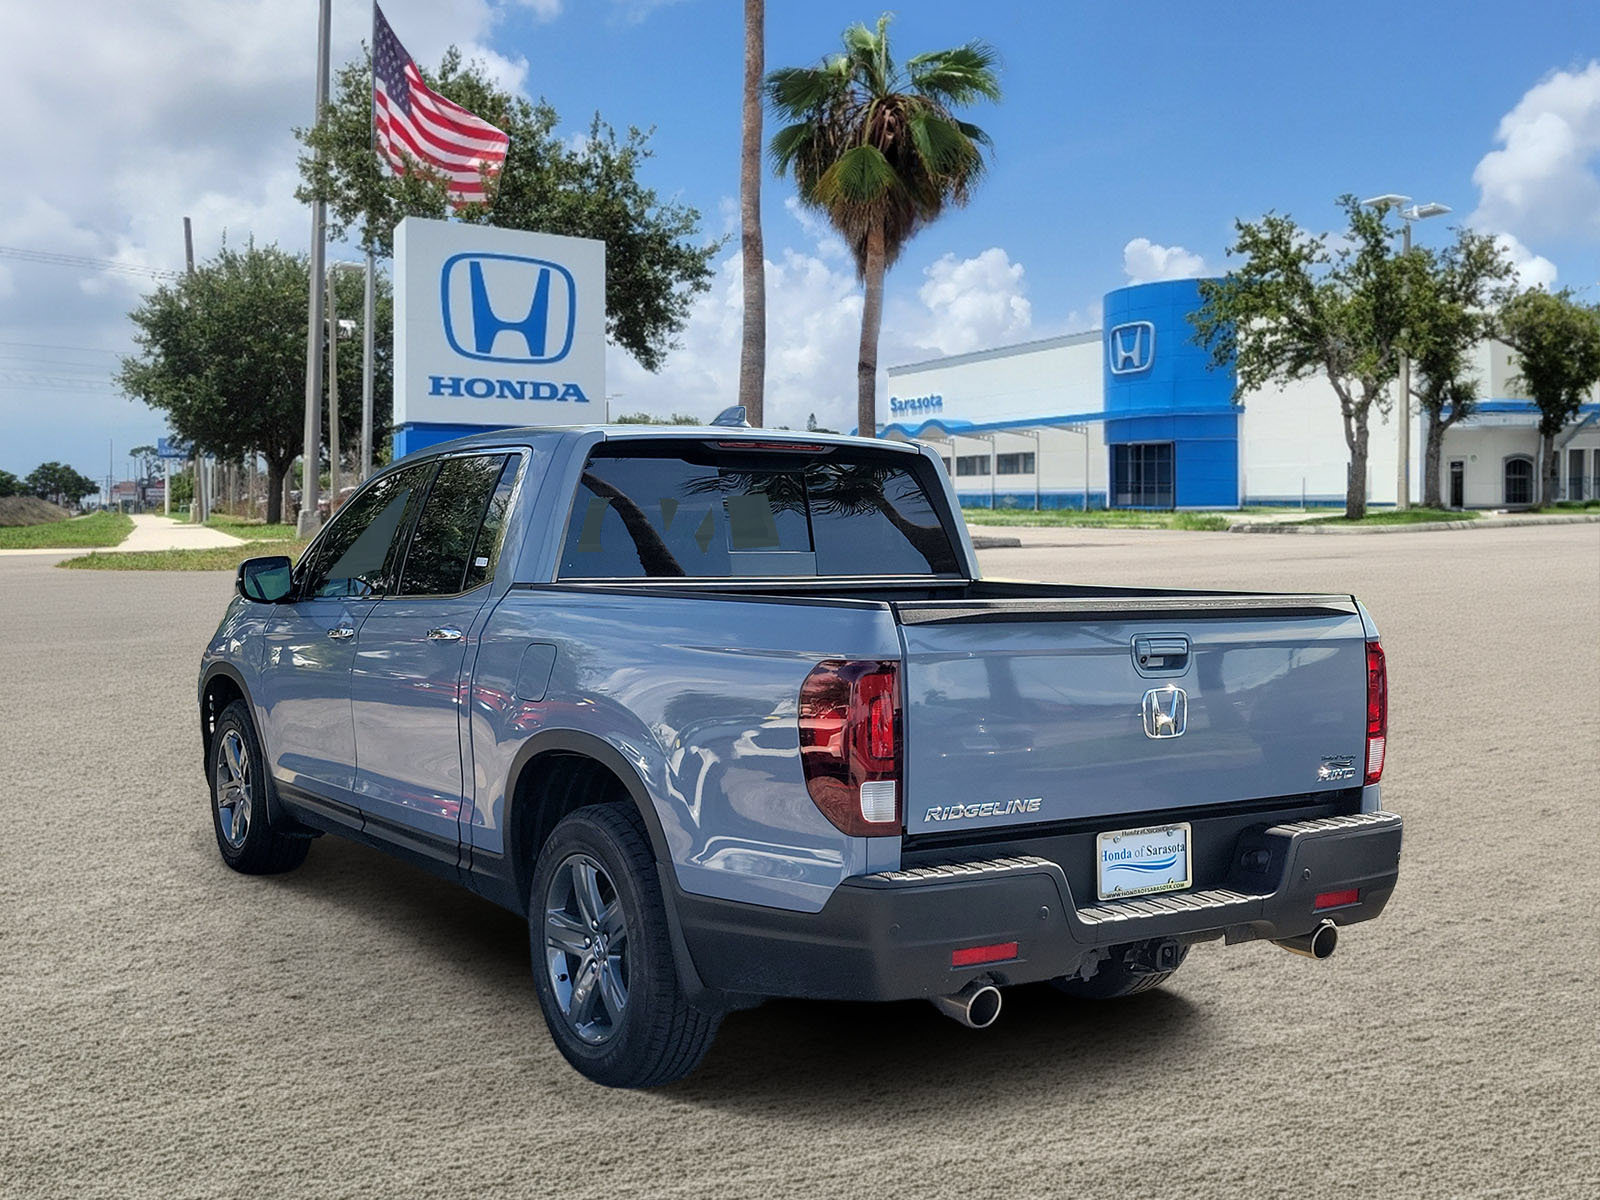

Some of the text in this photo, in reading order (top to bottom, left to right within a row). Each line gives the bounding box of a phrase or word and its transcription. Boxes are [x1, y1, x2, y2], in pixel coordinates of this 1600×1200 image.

[428, 376, 590, 403] HONDA
[890, 394, 943, 412] Sarasota
[924, 798, 1042, 822] RIDGELINE
[1101, 843, 1184, 862] Honda of Sarasota
